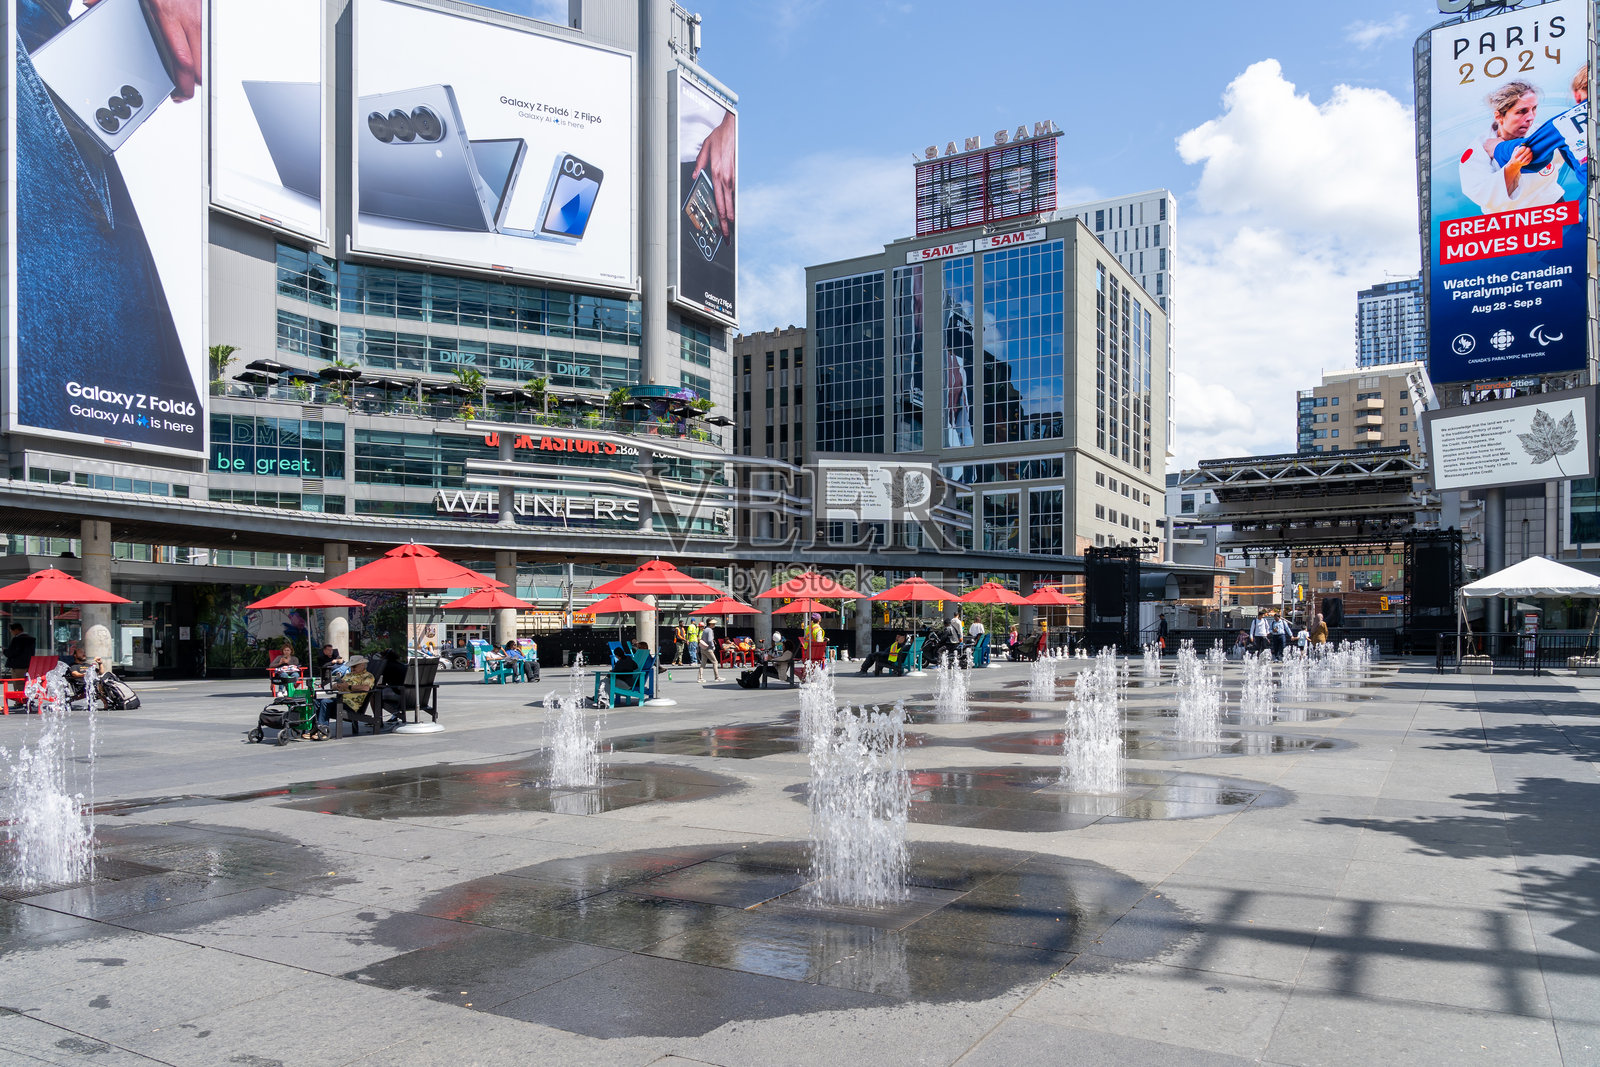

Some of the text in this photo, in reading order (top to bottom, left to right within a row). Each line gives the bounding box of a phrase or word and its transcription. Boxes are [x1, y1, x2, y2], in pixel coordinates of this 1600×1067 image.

[1458, 46, 1560, 85] 2024
[500, 96, 602, 124] Galaxy Z Fold6 Z Flip6
[518, 110, 544, 122] Galaxy
[568, 120, 585, 129] here
[924, 120, 1053, 160] SAM SAM
[1446, 206, 1568, 238] GREATNESS
[991, 232, 1024, 246] SAM
[1446, 231, 1556, 260] MOVES US.
[922, 245, 954, 259] SAM
[1444, 265, 1572, 290] Watch the Canadian
[1452, 279, 1563, 300] Paralympic Team
[704, 291, 720, 304] Galaxy
[723, 300, 732, 309] Flip6
[705, 300, 716, 309] Galaxy
[1472, 305, 1492, 314] Aug
[1514, 300, 1533, 308] Sep
[440, 350, 476, 366] DMZ
[499, 357, 535, 371] DMZ
[557, 363, 591, 377] DMZ
[1476, 379, 1534, 391] brandedcities
[66, 381, 196, 416] Galaxy Z Fold6
[70, 404, 194, 433] Galaxy AI is here
[233, 422, 300, 446] DMZ
[540, 436, 616, 455] ASTORS
[217, 452, 316, 474] be great.
